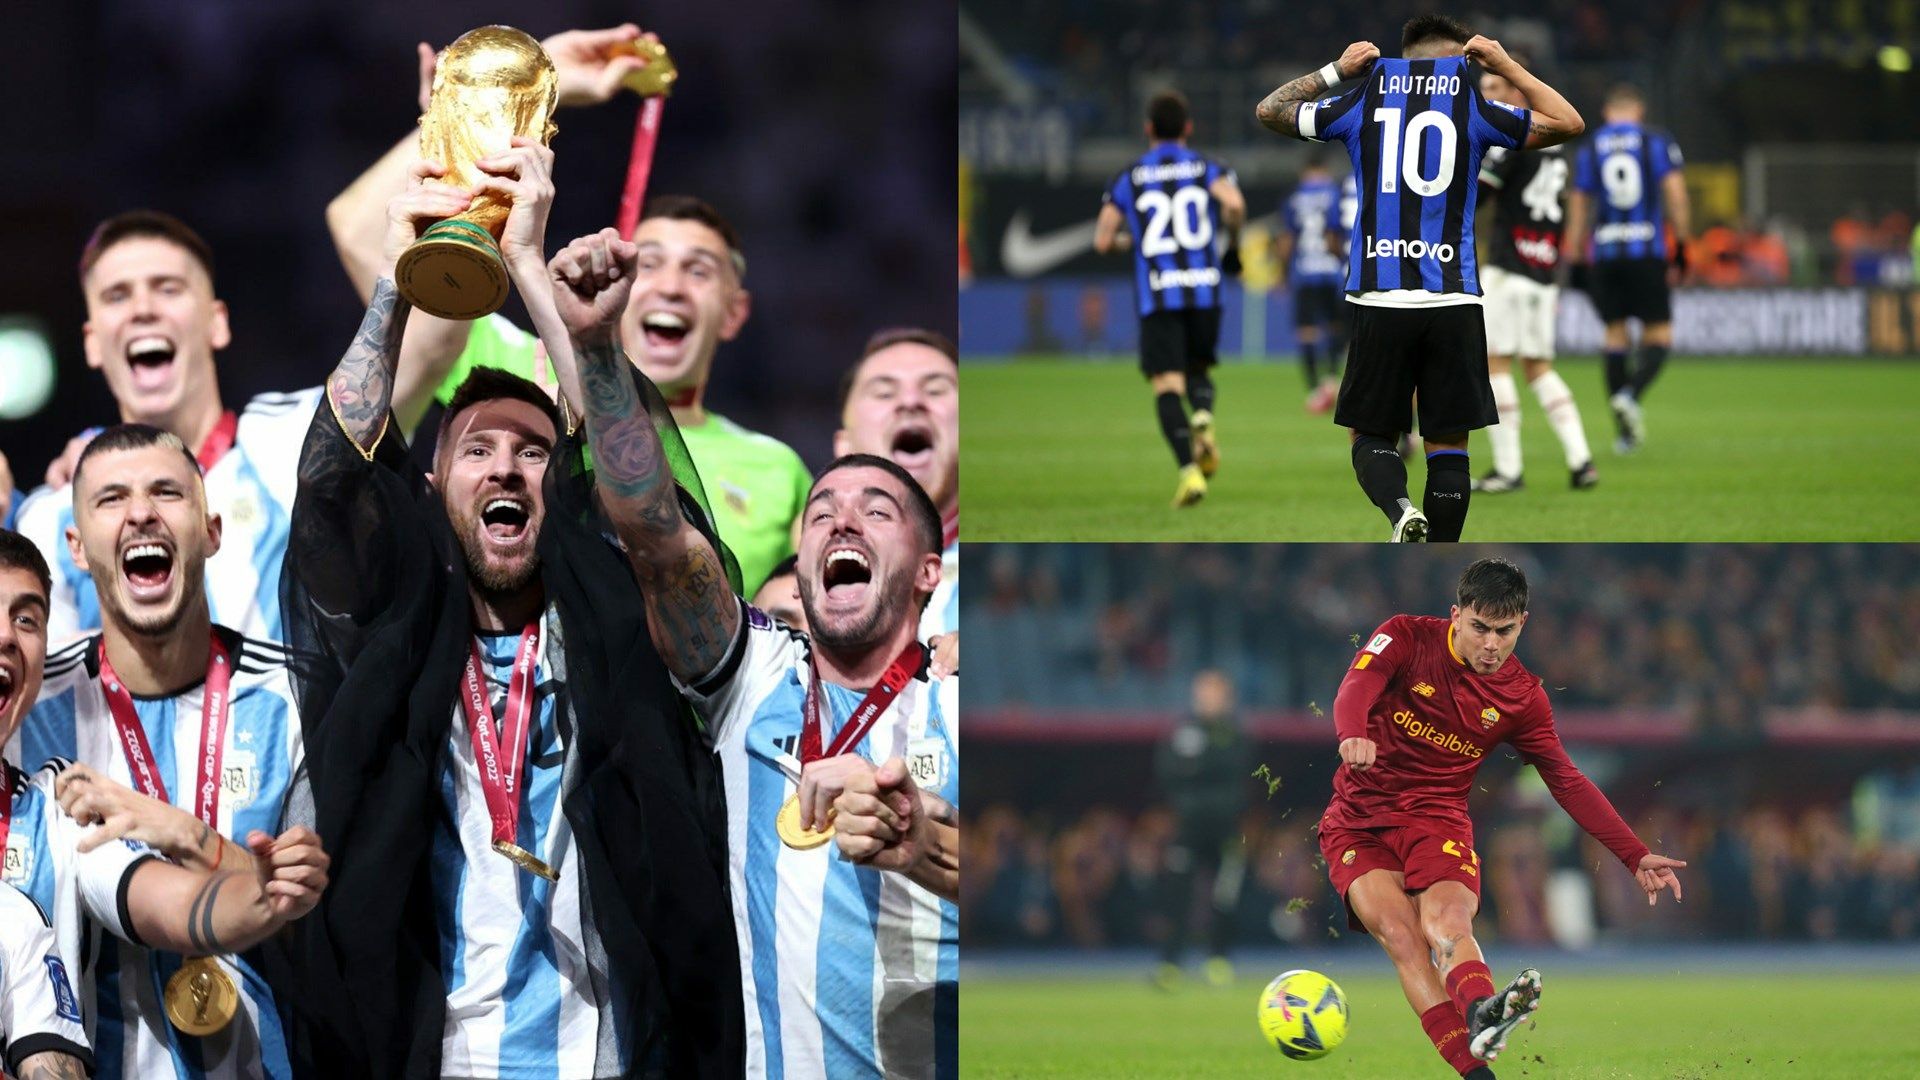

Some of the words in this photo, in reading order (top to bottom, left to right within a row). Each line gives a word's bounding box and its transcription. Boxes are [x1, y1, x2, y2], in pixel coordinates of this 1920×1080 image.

[1378, 75, 1461, 96] LAUTARO
[1373, 107, 1458, 197] 10
[1601, 152, 1644, 211] 9
[1135, 185, 1213, 258] 20
[1366, 235, 1454, 263] Lenovo
[471, 691, 483, 712] CUP
[1393, 710, 1484, 758] digitalbits
